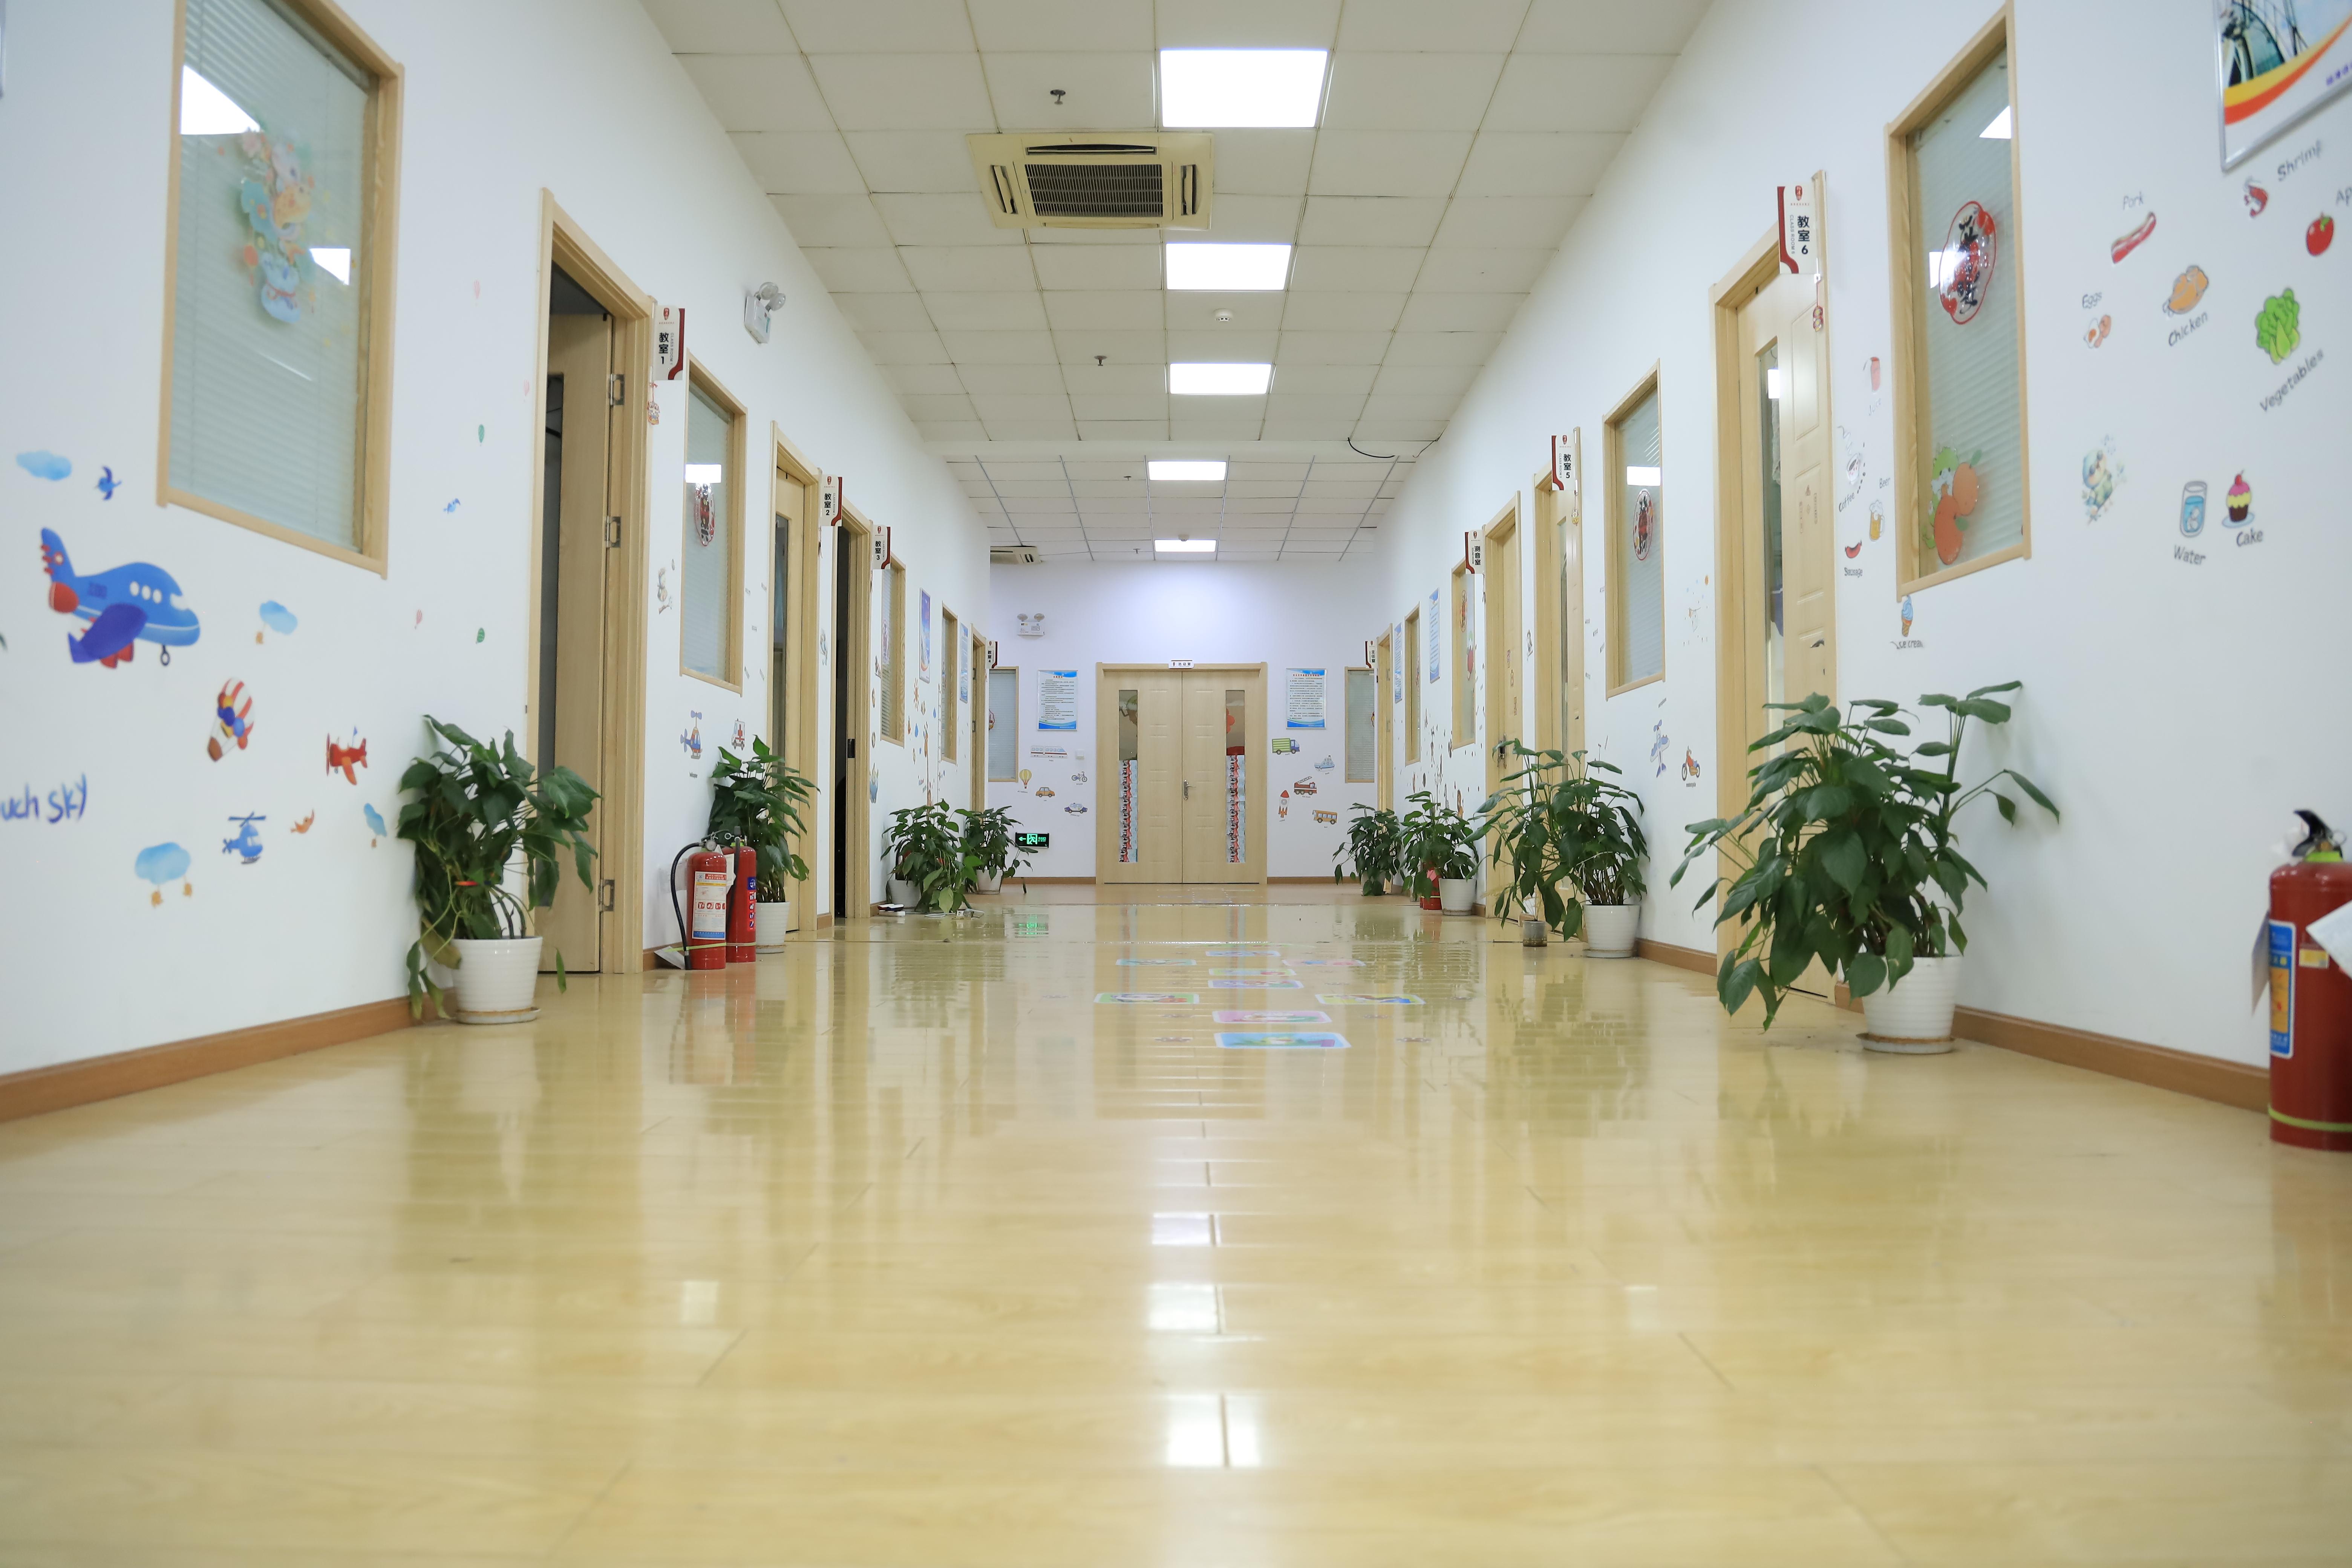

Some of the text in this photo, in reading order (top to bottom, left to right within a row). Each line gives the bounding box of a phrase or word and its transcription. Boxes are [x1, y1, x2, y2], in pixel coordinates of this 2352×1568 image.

[2122, 191, 2144, 211] Pork
[1797, 215, 1810, 255] 教室6
[2082, 291, 2102, 309] Eggs
[2168, 311, 2209, 346] Chicken
[658, 332, 669, 364] 教室1
[2259, 349, 2325, 412] Vegetables
[1879, 477, 1891, 489] Beer
[2236, 528, 2263, 547] Cake
[2173, 544, 2207, 565] Water
[1844, 567, 1863, 578] Sausage
